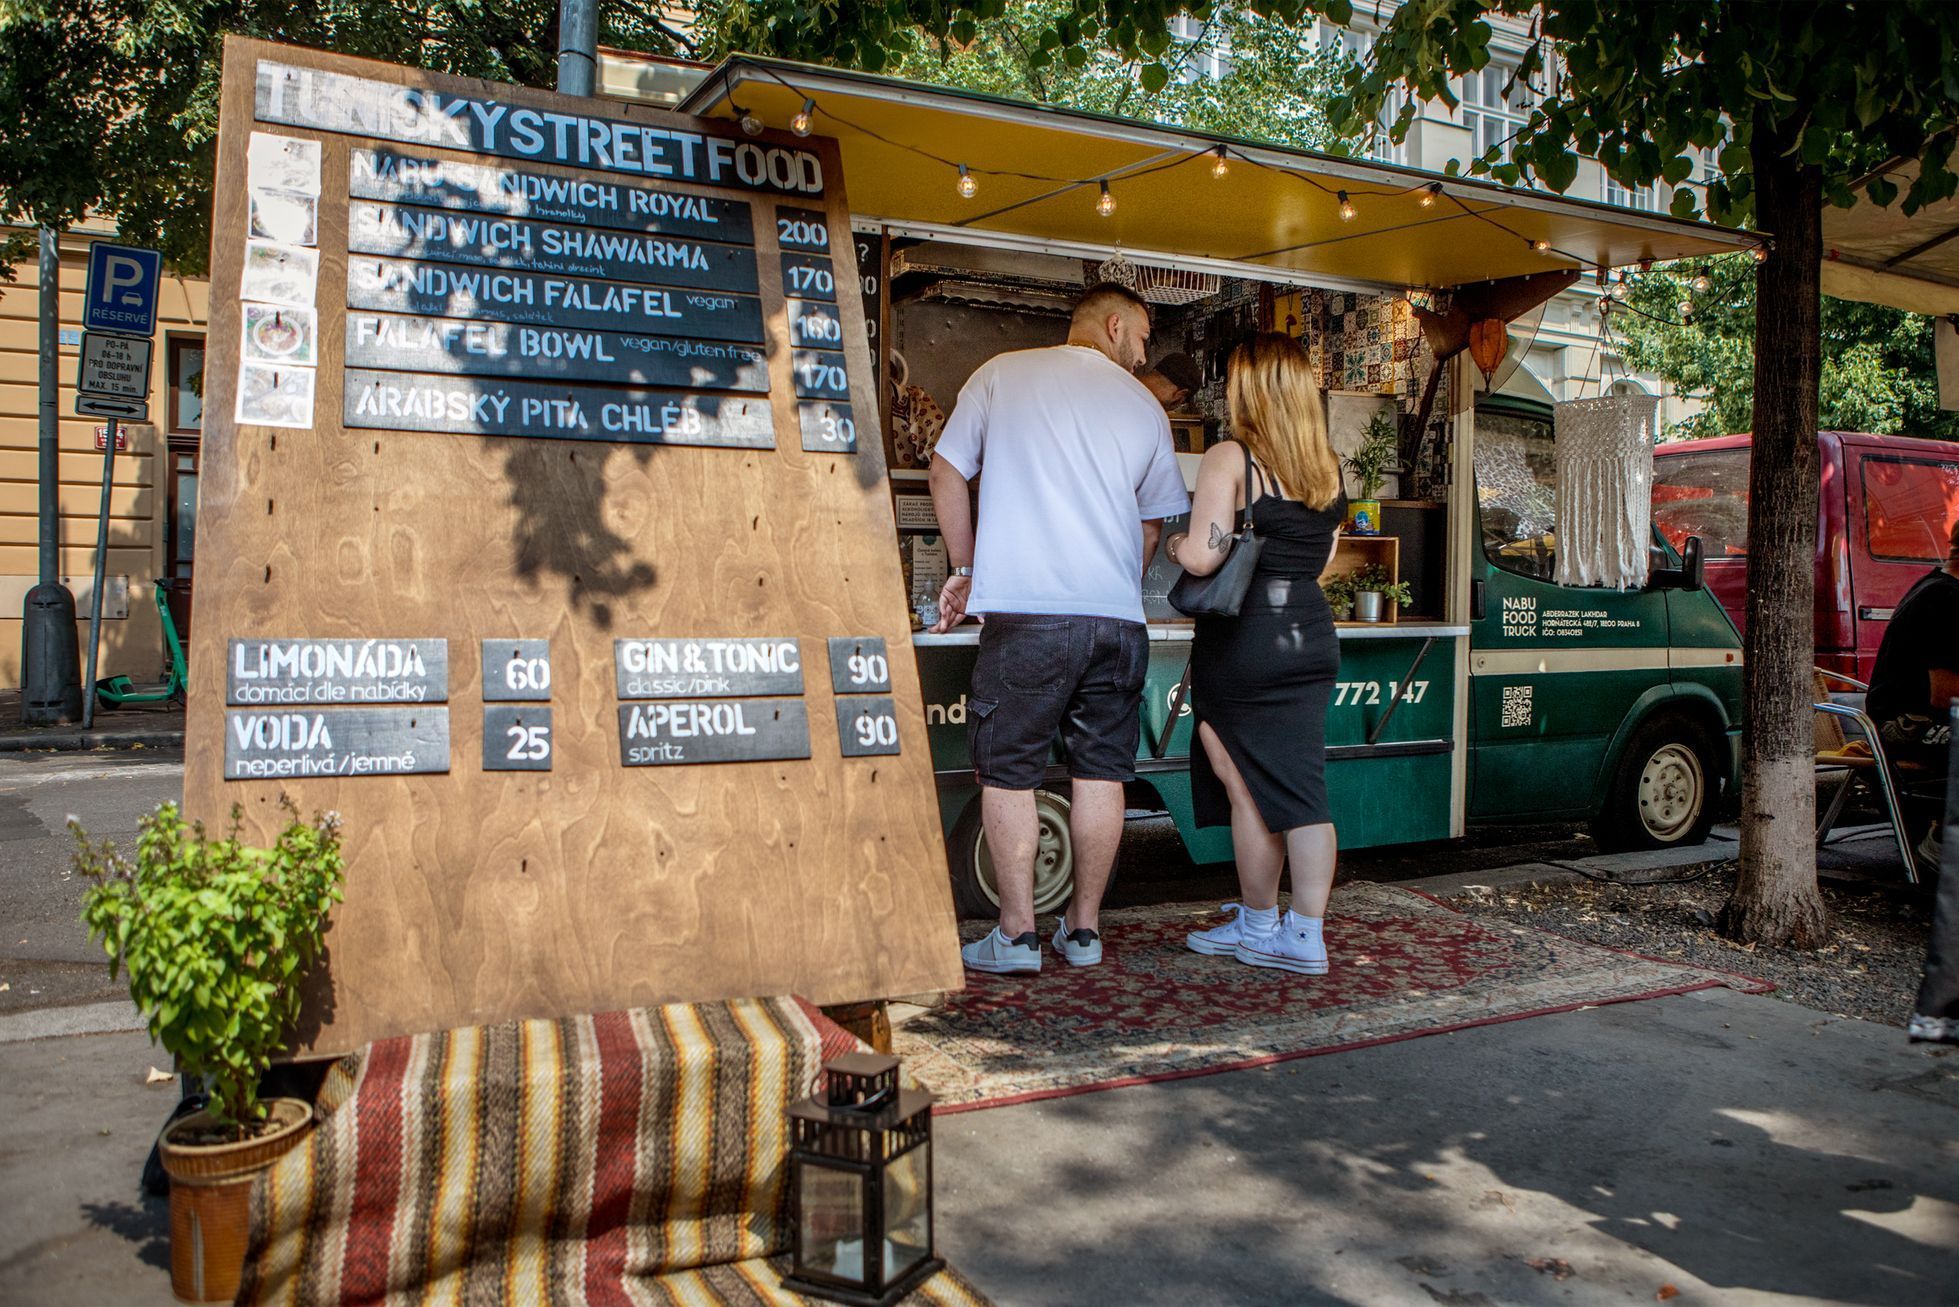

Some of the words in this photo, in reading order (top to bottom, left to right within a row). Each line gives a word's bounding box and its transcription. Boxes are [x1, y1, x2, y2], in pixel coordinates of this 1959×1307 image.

[509, 109, 703, 178] STREET
[707, 137, 824, 193] FOOD
[353, 152, 444, 188] NABU
[457, 165, 618, 210] SANDWICH
[629, 189, 718, 223] ROYAL
[357, 206, 531, 251] SANDWICH
[542, 229, 709, 271] SHAWARMA
[777, 219, 828, 246] 200
[357, 262, 533, 305] SANDWICH
[544, 279, 682, 318] FALAFEL
[686, 294, 736, 310] vegan
[788, 266, 833, 293] 170
[92, 306, 149, 326] RÉSERVÉ
[797, 316, 841, 342] 160
[105, 338, 130, 352] PO-PÁ
[357, 318, 508, 356] FALAFEL
[520, 328, 615, 362] BOWL
[88, 358, 103, 369] PRO
[106, 360, 143, 374] DOPRAVNÍ
[98, 370, 132, 382] OBSLUHU
[801, 363, 848, 391] 170
[111, 382, 120, 392] 15
[356, 384, 510, 424] ARABSKÝ
[521, 398, 588, 429] PITA
[601, 400, 700, 435] CHLÉB
[820, 417, 856, 443] 30
[1503, 597, 1536, 610] NABU
[1581, 610, 1608, 618] LAKHDAR
[1503, 611, 1537, 624] FOOD
[1503, 625, 1537, 637] TRUCK
[1617, 620, 1635, 628] PRAHA
[235, 638, 426, 679] LIMONÁDA
[847, 655, 889, 685] 90
[506, 658, 550, 690] 60
[236, 682, 309, 703] domácí
[315, 682, 346, 701] dle
[352, 680, 427, 703] nabídky
[1335, 681, 1380, 706] 772
[1389, 681, 1430, 704] 147
[234, 713, 333, 750] VODA
[627, 703, 756, 739] APEROL
[855, 715, 897, 746] 90
[507, 726, 550, 760] 25
[629, 741, 685, 763] spritz
